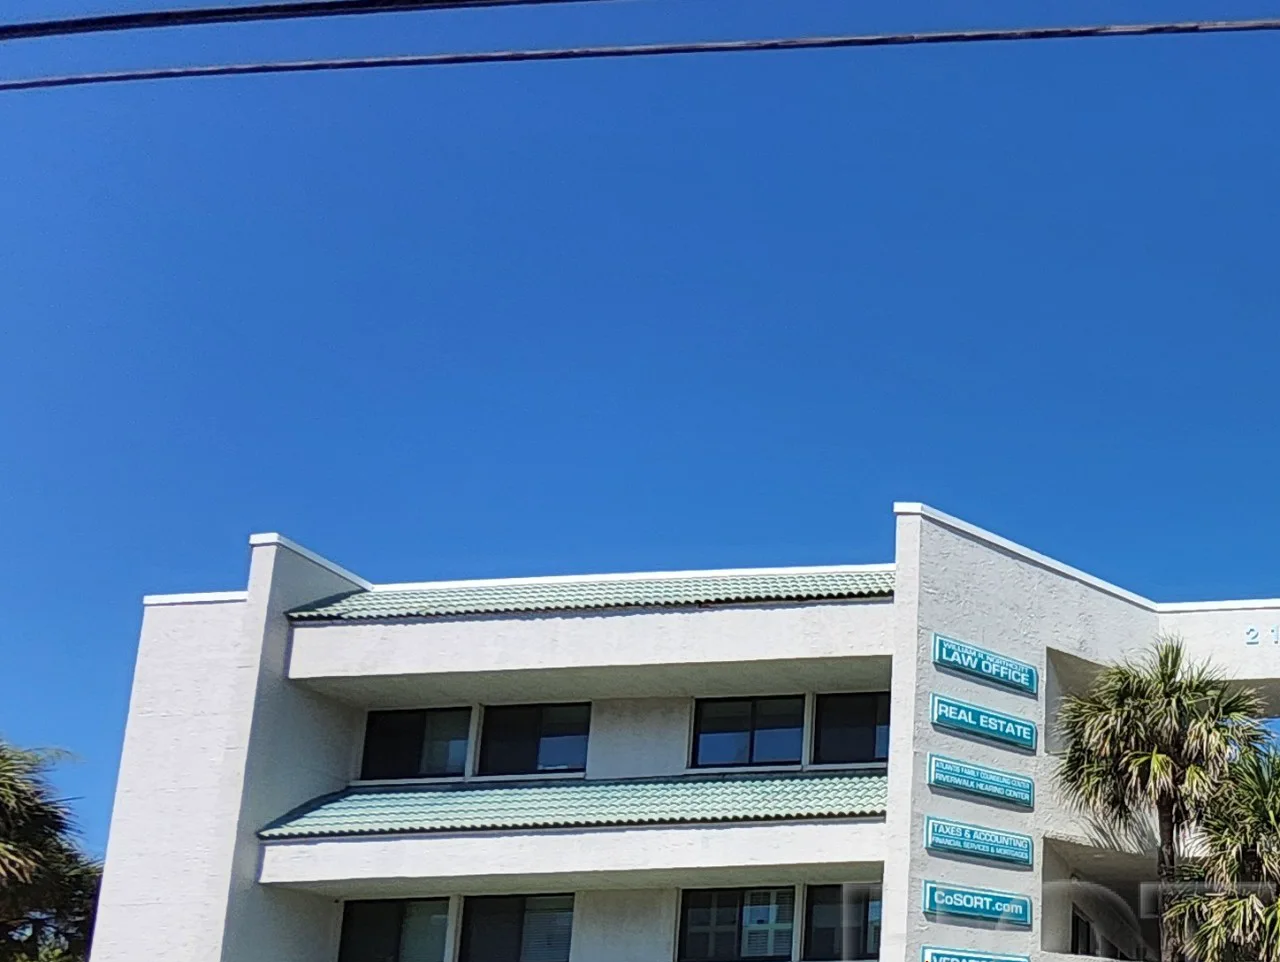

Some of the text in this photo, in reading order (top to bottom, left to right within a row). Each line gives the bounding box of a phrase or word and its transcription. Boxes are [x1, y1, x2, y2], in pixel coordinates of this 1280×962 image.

[942, 641, 977, 656] WILLIAM
[942, 647, 1030, 686] LAW OFFICE
[938, 703, 1031, 740] REAL ESTATE
[935, 773, 1030, 801] RIVERWALK HEARING CENTER
[1011, 778, 1030, 790] CENTER
[932, 836, 962, 848] FINANCIAL
[962, 841, 989, 852] SERVICES
[933, 823, 962, 837] TAXES
[973, 830, 1028, 849] ACCOUNTING
[934, 890, 1023, 914] CoSORT.com
